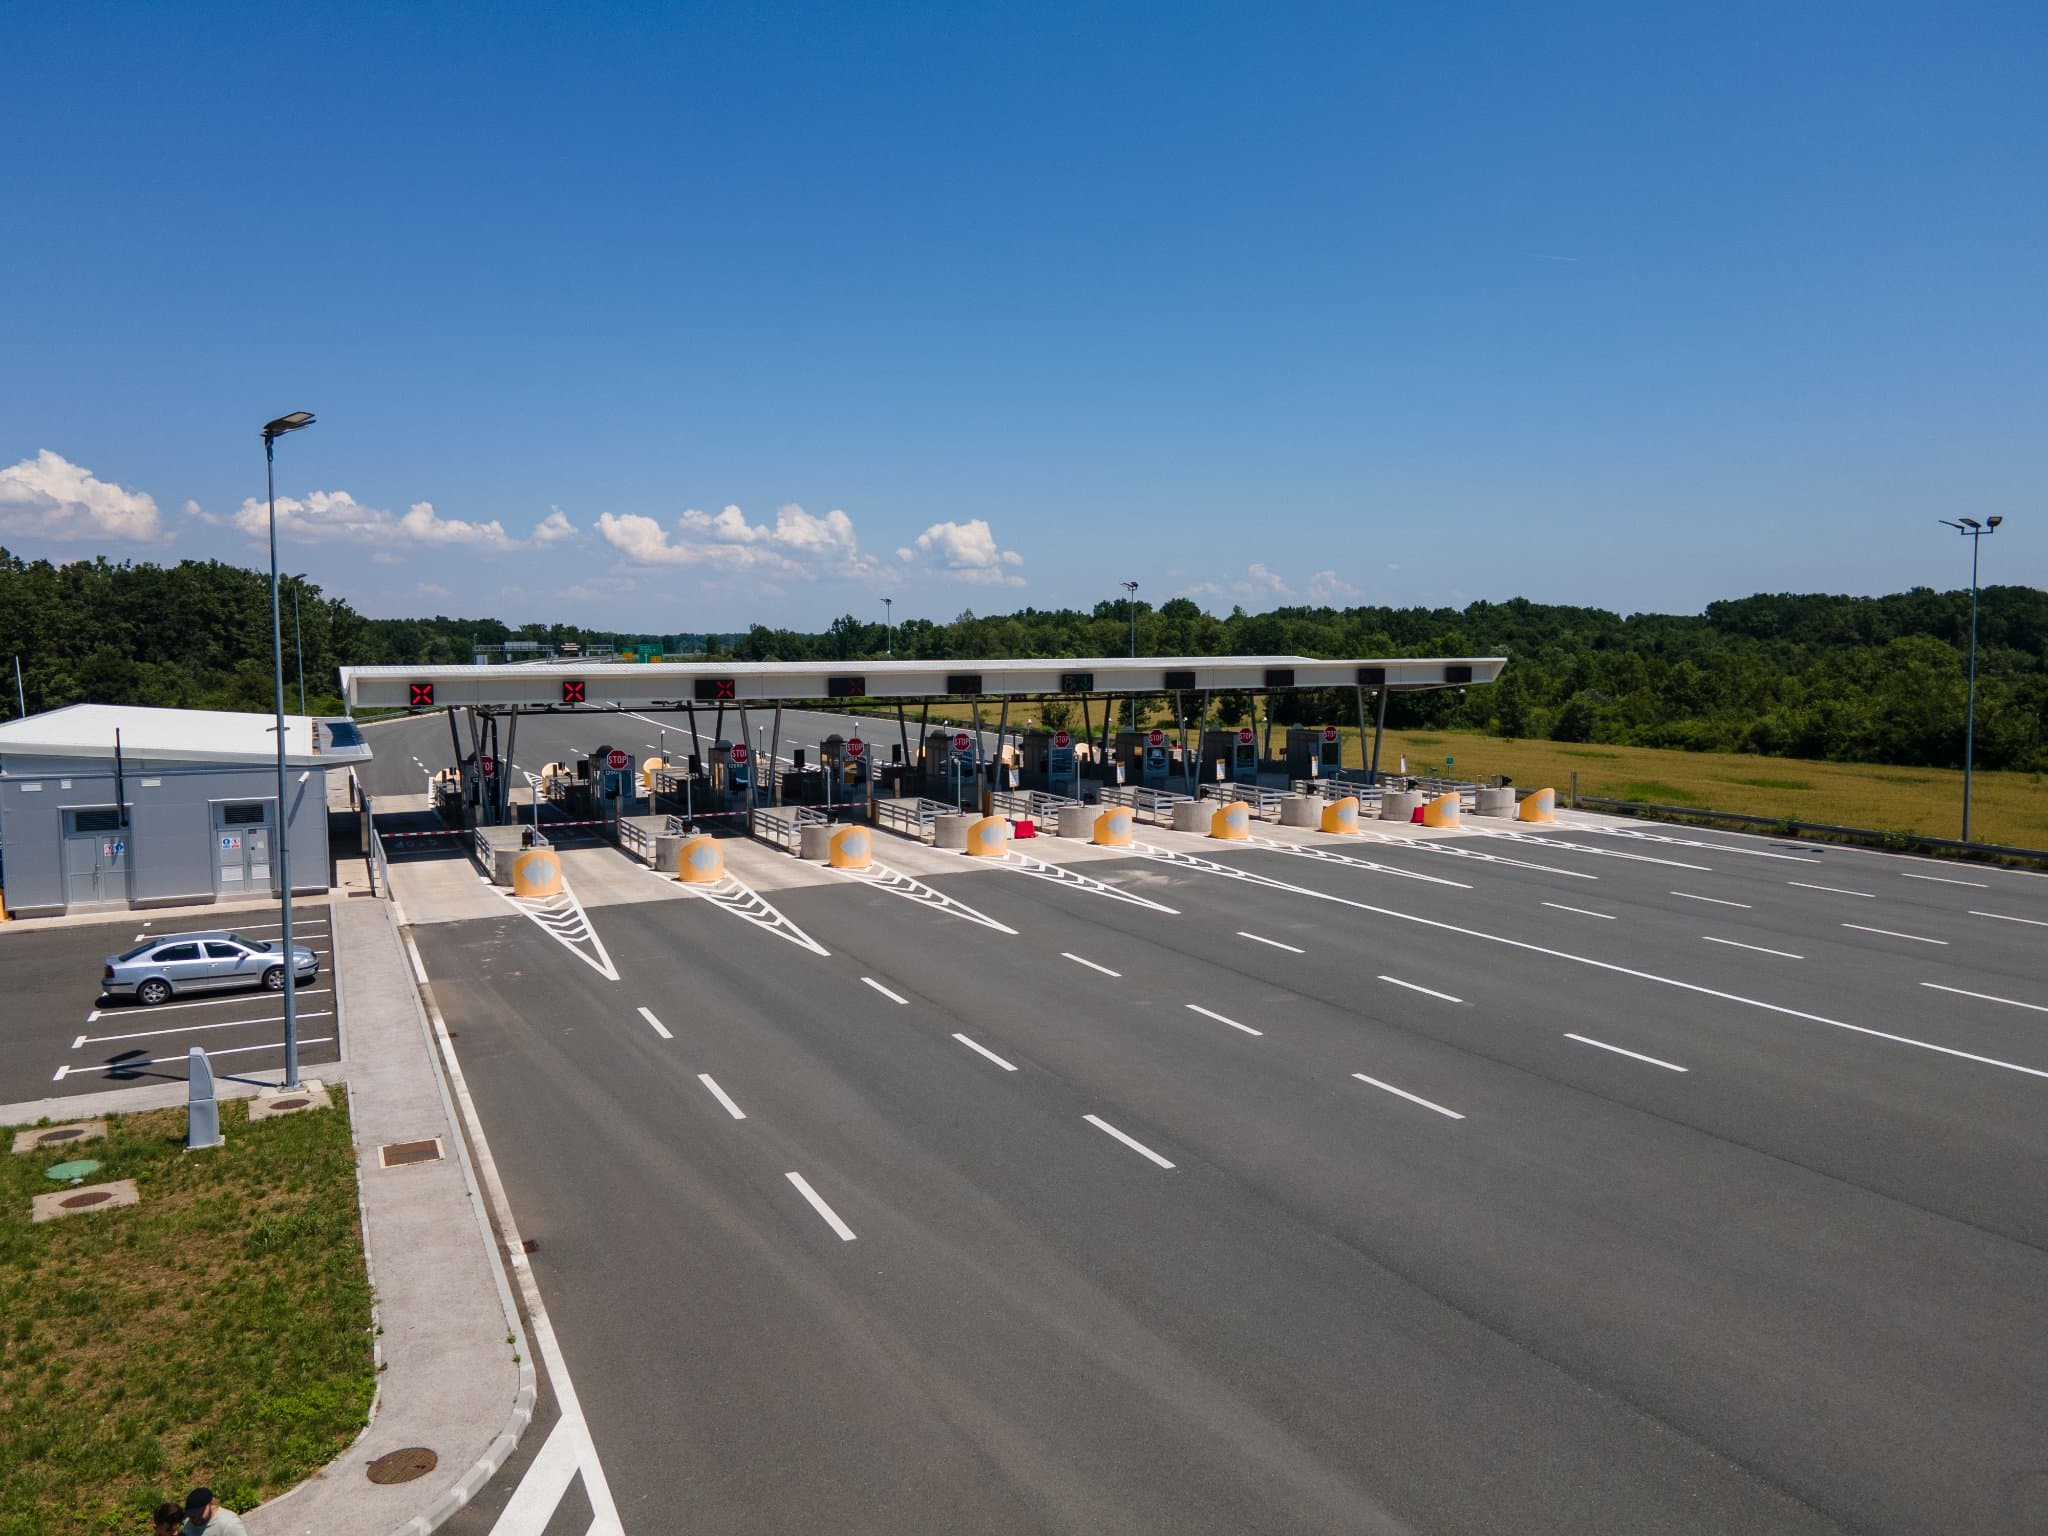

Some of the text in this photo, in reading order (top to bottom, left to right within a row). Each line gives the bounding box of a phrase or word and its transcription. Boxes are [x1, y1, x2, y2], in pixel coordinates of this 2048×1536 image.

[954, 737, 969, 745] STOP
[1055, 735, 1068, 743] STOP
[847, 743, 863, 751] STOP
[608, 755, 627, 764] STOP
